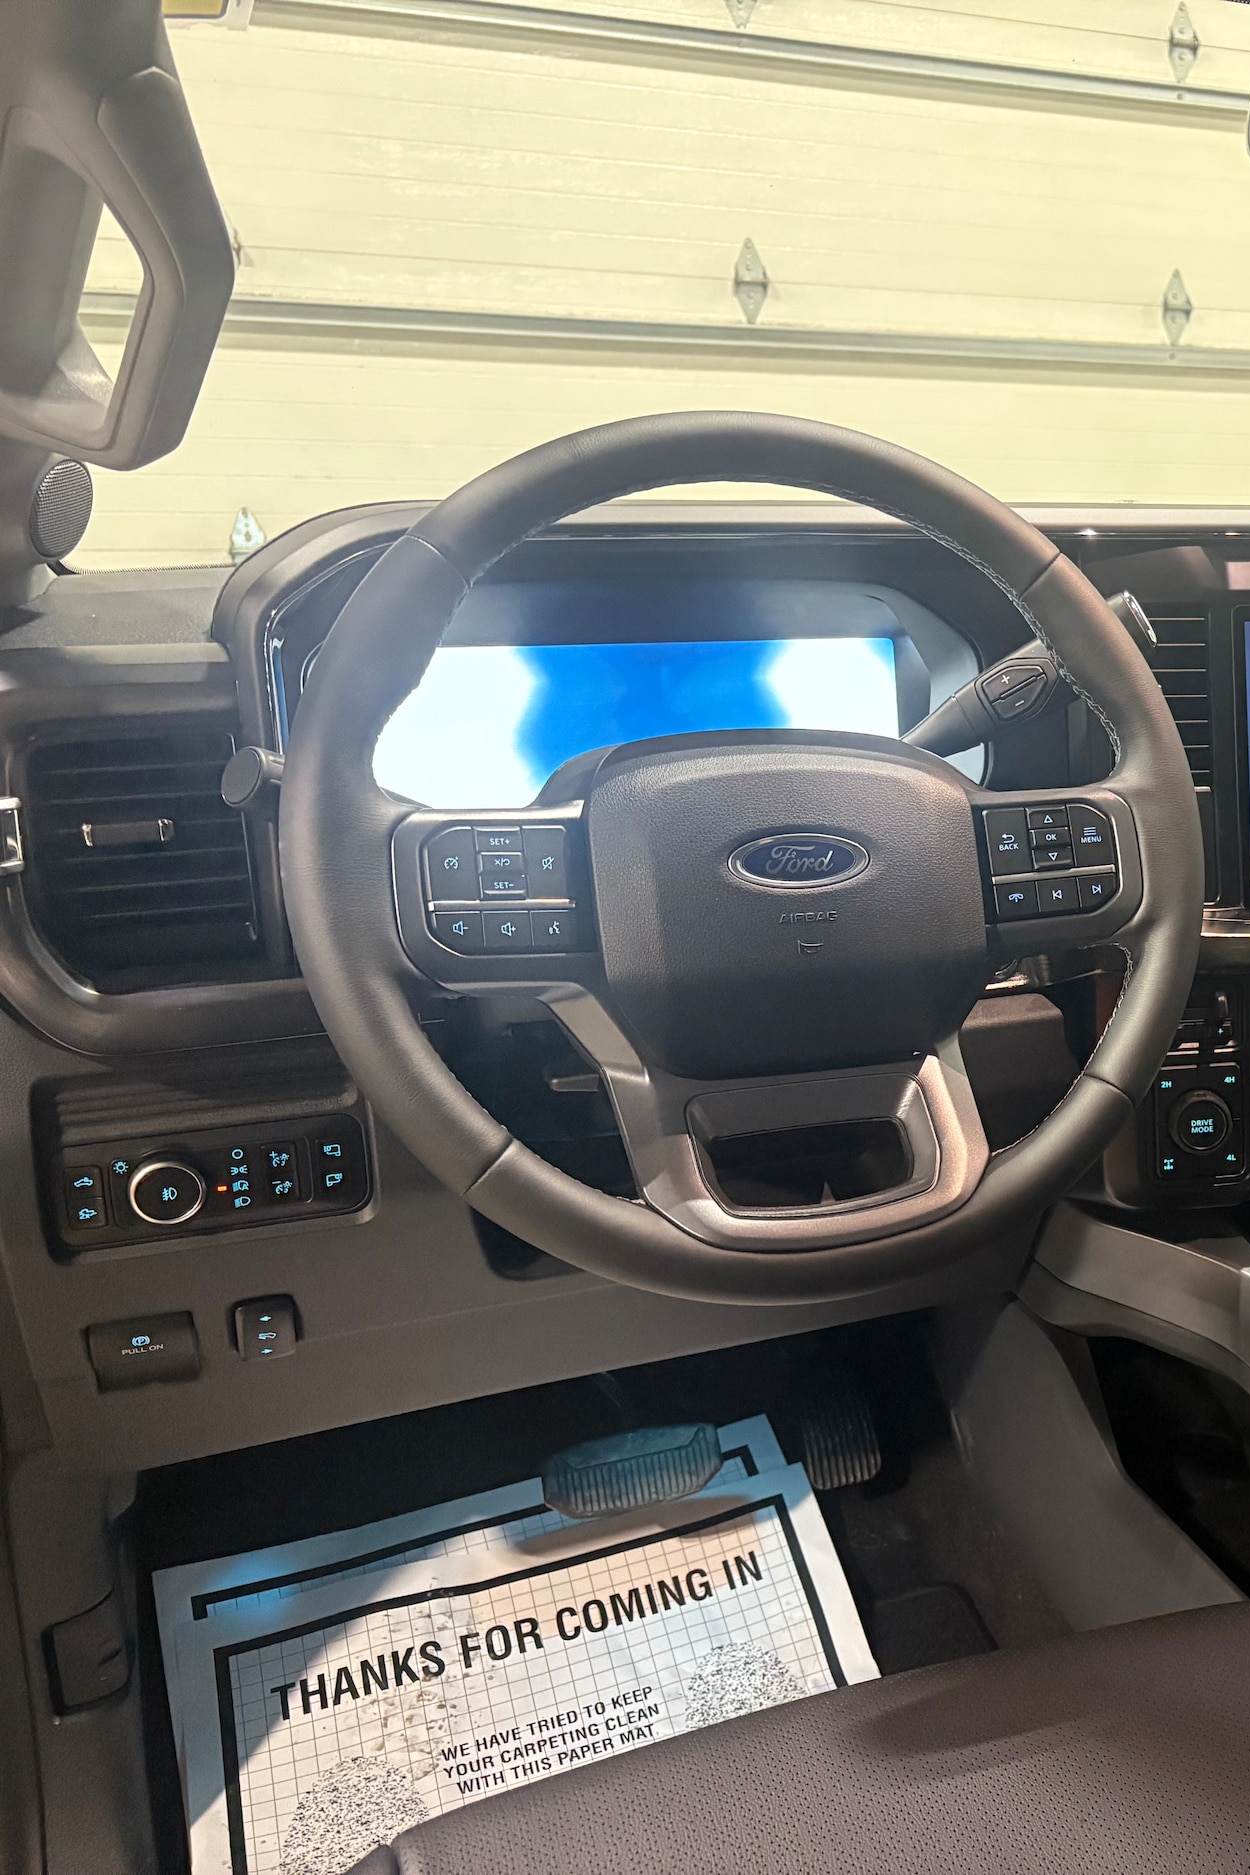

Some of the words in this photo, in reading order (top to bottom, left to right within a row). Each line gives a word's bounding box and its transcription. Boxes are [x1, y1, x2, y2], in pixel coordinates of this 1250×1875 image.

[489, 838, 511, 846] SET+
[1080, 836, 1102, 844] MENU
[998, 843, 1019, 852] BACK
[765, 845, 834, 875] Ford
[778, 910, 838, 924] AIRBAG
[1160, 1080, 1172, 1089] 2H
[1223, 1076, 1236, 1084] 4H
[1190, 1119, 1214, 1127] DRIVE
[1190, 1126, 1214, 1134] MODE
[121, 1347, 147, 1356] PULL
[148, 1343, 164, 1352] ON
[270, 1640, 446, 1721] THANKS
[459, 1617, 545, 1669] FOR
[555, 1568, 714, 1641] COMING
[721, 1550, 763, 1591] IN
[441, 1742, 471, 1762] WE
[475, 1727, 521, 1752] HAVE
[526, 1710, 578, 1734] TRIED
[583, 1701, 607, 1719] TO
[611, 1686, 653, 1710] KEEP
[443, 1755, 496, 1779] YOUR
[500, 1723, 600, 1764] CARPETING
[604, 1703, 660, 1732] CLEAN
[457, 1772, 506, 1795] WITH
[511, 1757, 552, 1780] THIS
[558, 1737, 615, 1766] PAPER
